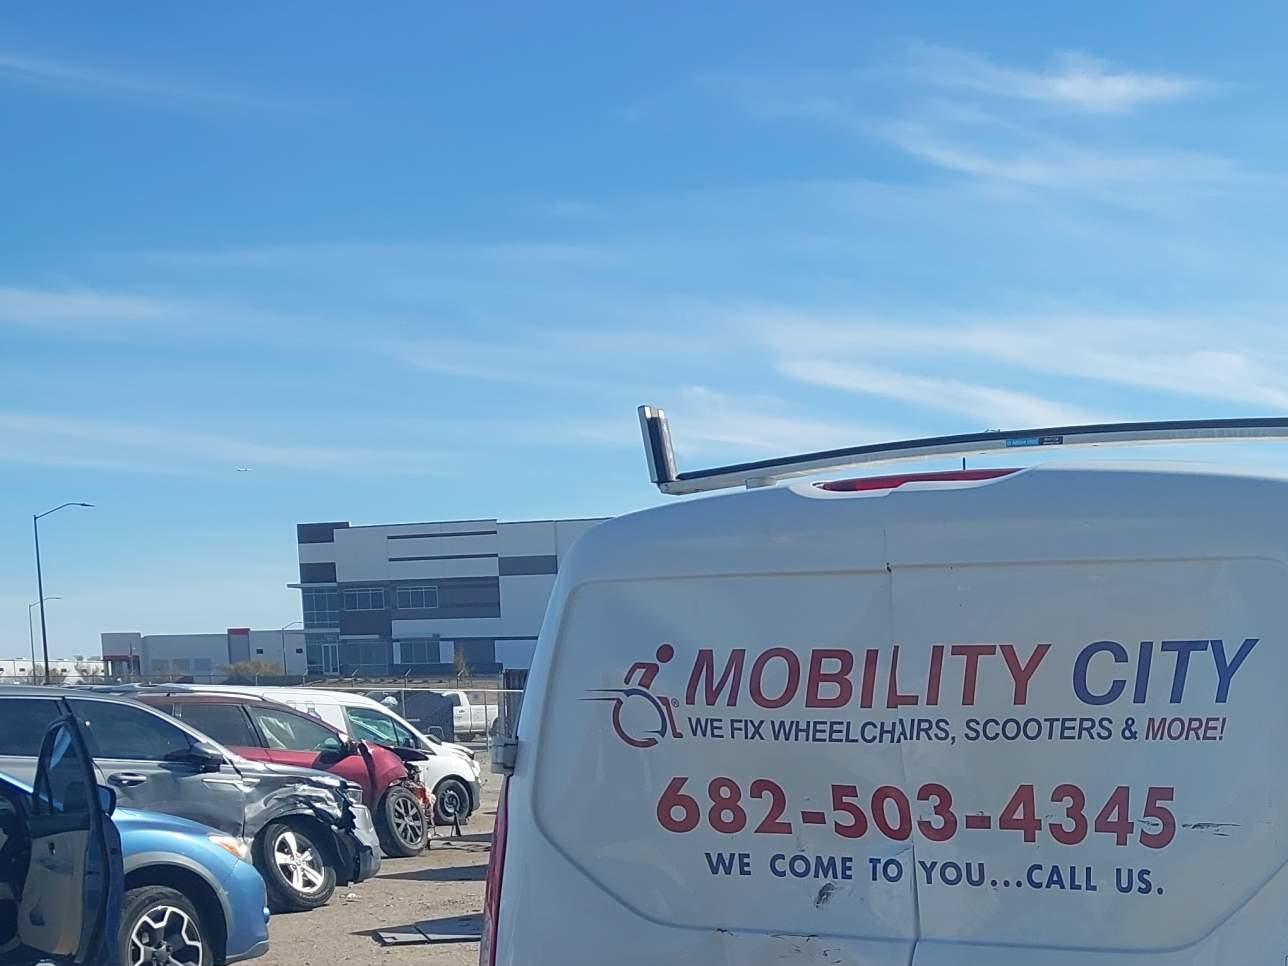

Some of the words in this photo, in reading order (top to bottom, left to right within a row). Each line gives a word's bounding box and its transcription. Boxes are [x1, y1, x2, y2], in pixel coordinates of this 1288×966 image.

[685, 643, 1052, 709] MOBILITY
[1073, 638, 1260, 705] CITY
[688, 717, 723, 738] WE
[730, 718, 765, 740] FIX
[771, 717, 957, 745] WHEELCHAIRS,
[964, 716, 1113, 741] SCOOTERS
[1121, 717, 1138, 741] &
[1145, 717, 1227, 741] MORE!
[656, 776, 1176, 849] 682-503-4345
[705, 852, 752, 876] WE
[769, 853, 853, 880] COME
[869, 857, 904, 883] TO
[1115, 868, 1164, 895] US.
